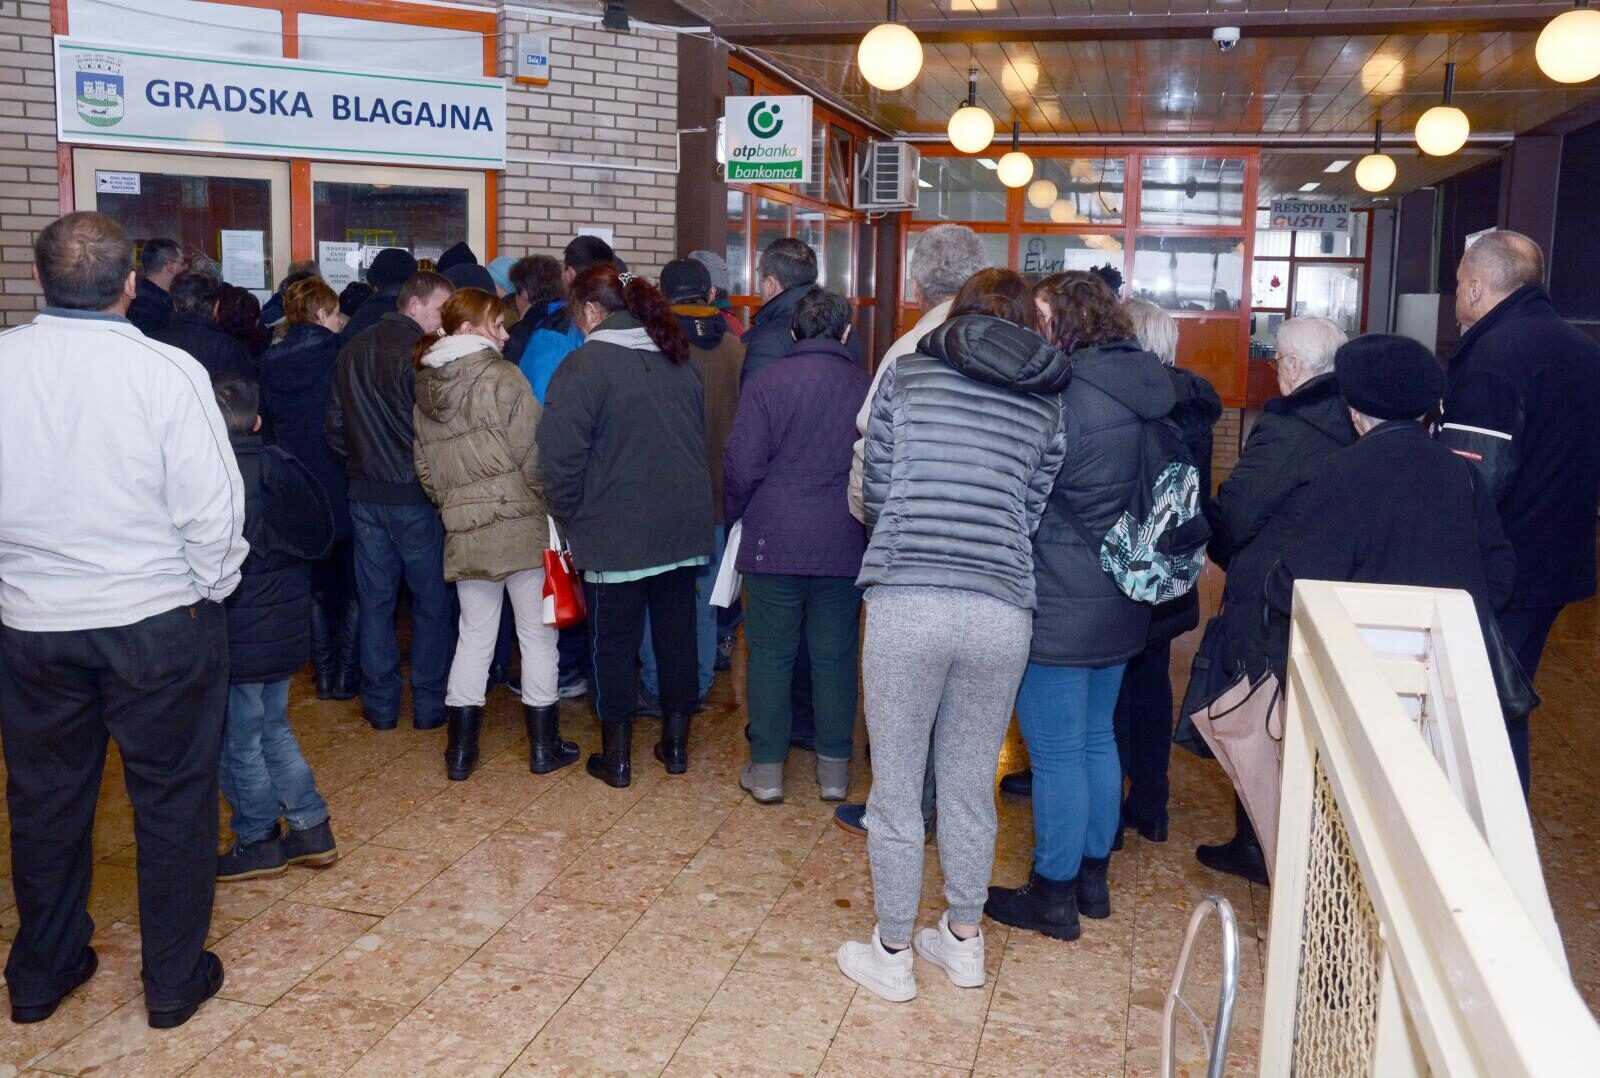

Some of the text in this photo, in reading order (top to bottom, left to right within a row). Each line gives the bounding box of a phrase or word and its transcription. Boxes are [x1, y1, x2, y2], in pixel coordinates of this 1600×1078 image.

[145, 79, 493, 132] GRADSKA BLAGAJNA
[733, 144, 797, 160] otpbanka
[735, 165, 797, 178] bankomat
[1274, 203, 1347, 214] RESTORAN
[1273, 214, 1347, 228] GUŠTI 2
